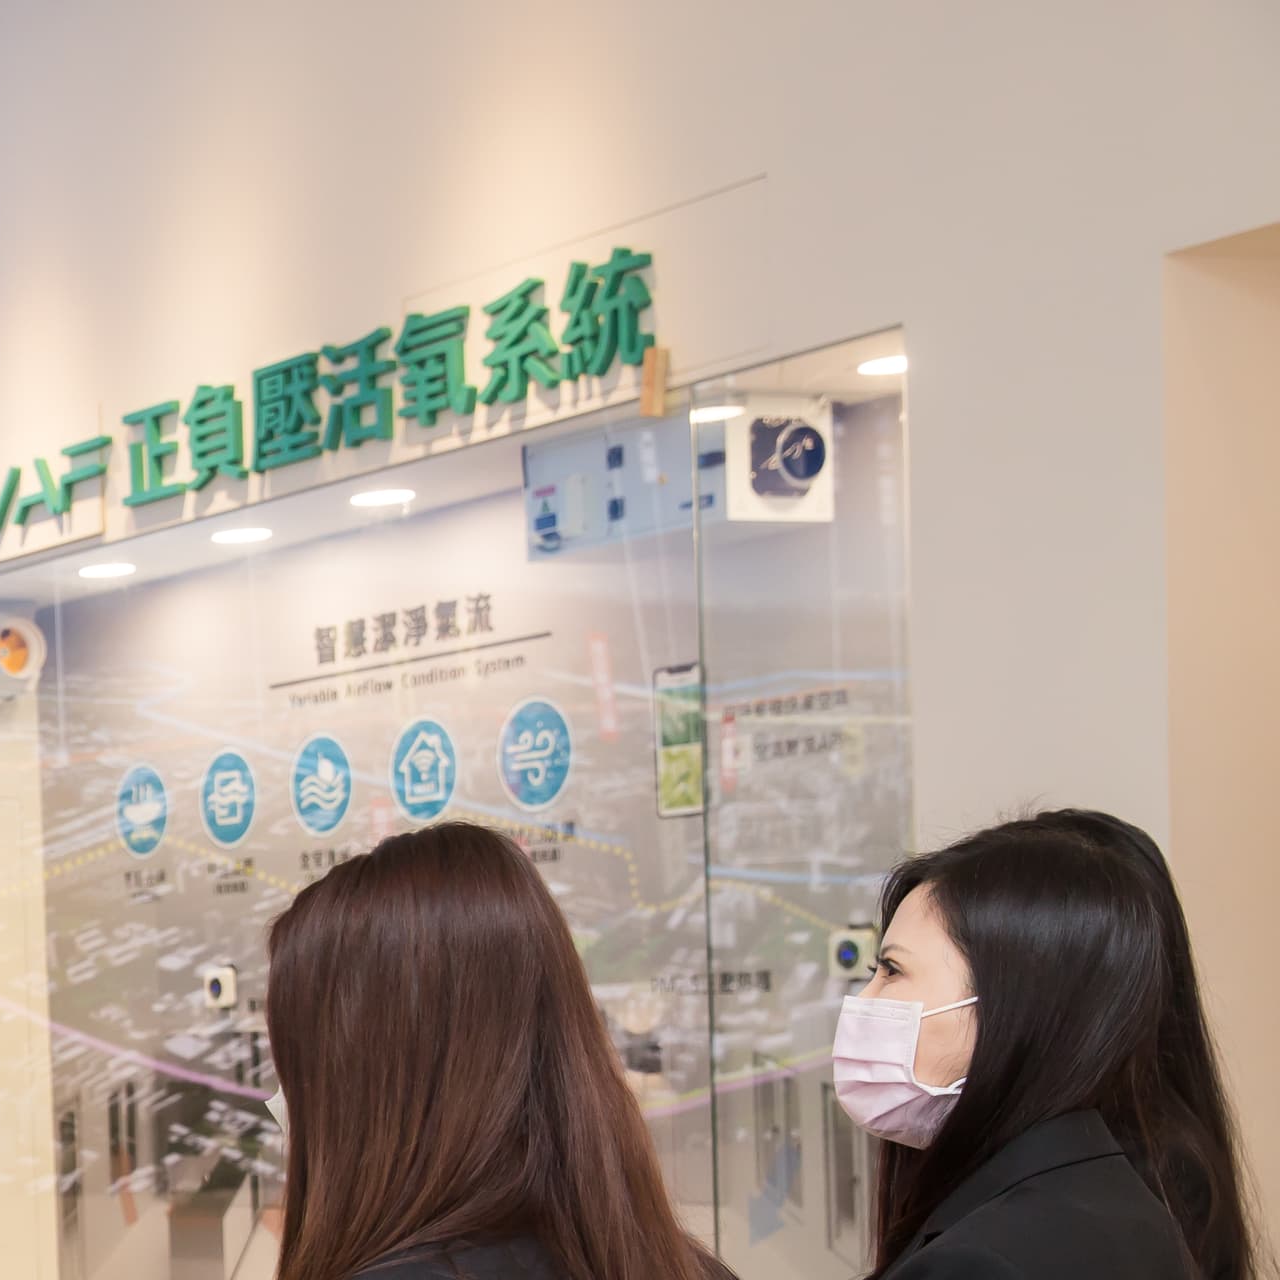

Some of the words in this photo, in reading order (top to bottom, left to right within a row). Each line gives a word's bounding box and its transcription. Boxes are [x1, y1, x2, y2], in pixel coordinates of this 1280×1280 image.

[122, 247, 656, 508] 正負壓活氧系統
[400, 664, 466, 690] Condition
[475, 653, 527, 678] System
